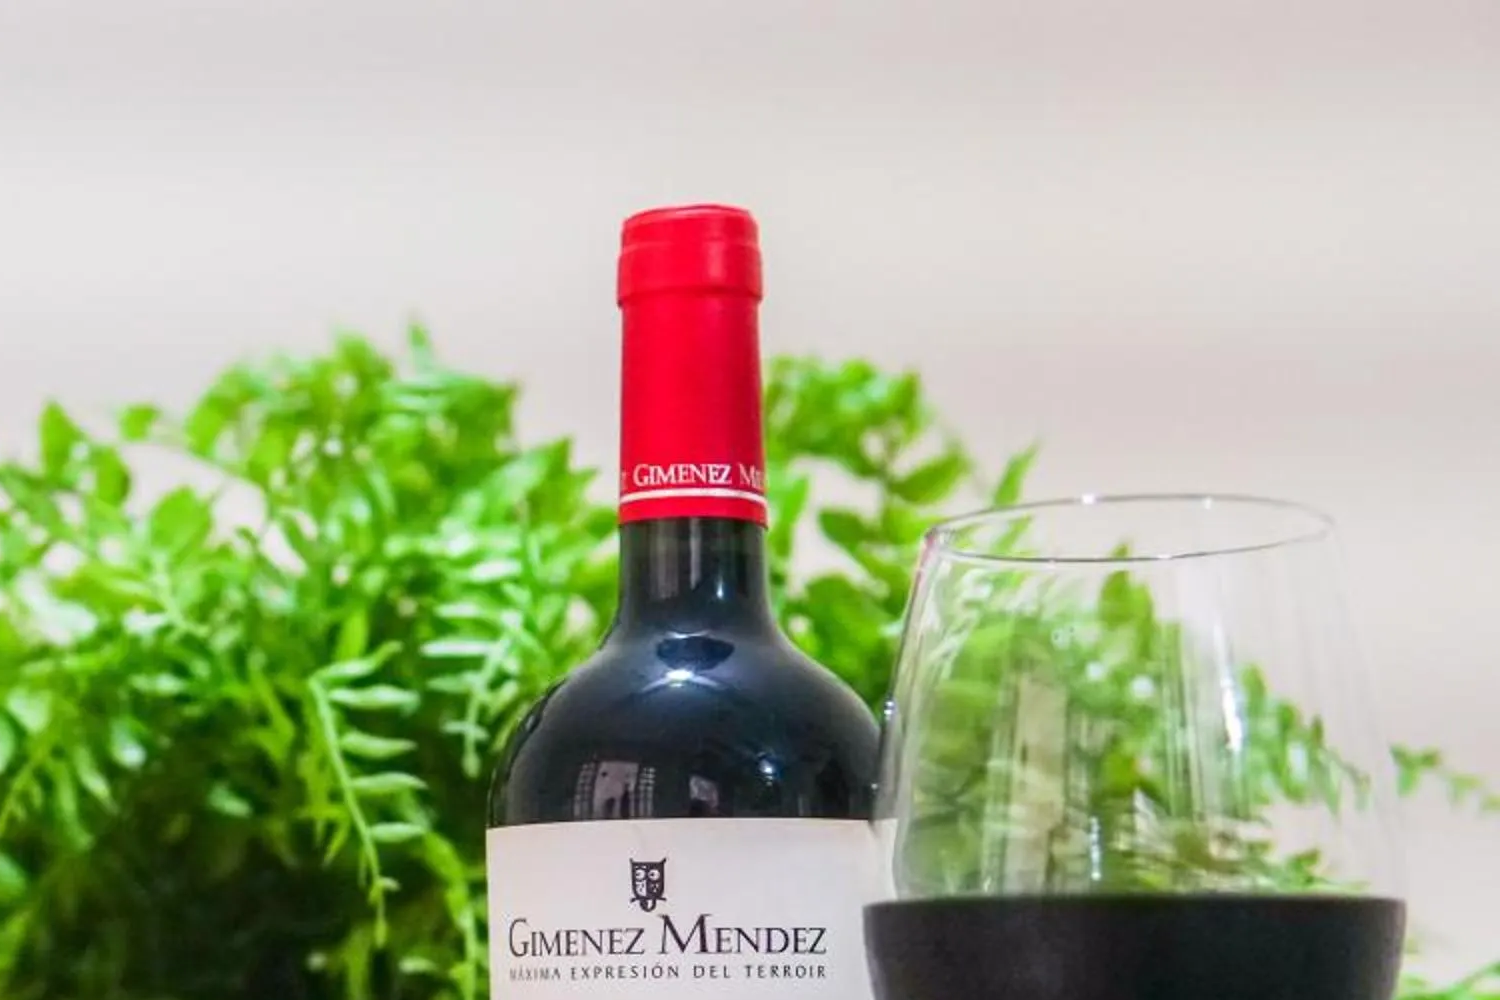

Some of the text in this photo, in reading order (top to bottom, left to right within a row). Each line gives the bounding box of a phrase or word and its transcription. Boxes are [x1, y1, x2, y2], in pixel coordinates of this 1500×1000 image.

[633, 463, 732, 487] GIMENEZ
[509, 913, 827, 957] GIMENEZ MENDEZ
[570, 961, 680, 980] EXPRESIÓN
[693, 964, 731, 979] DEL
[744, 964, 827, 979] TERROIR
